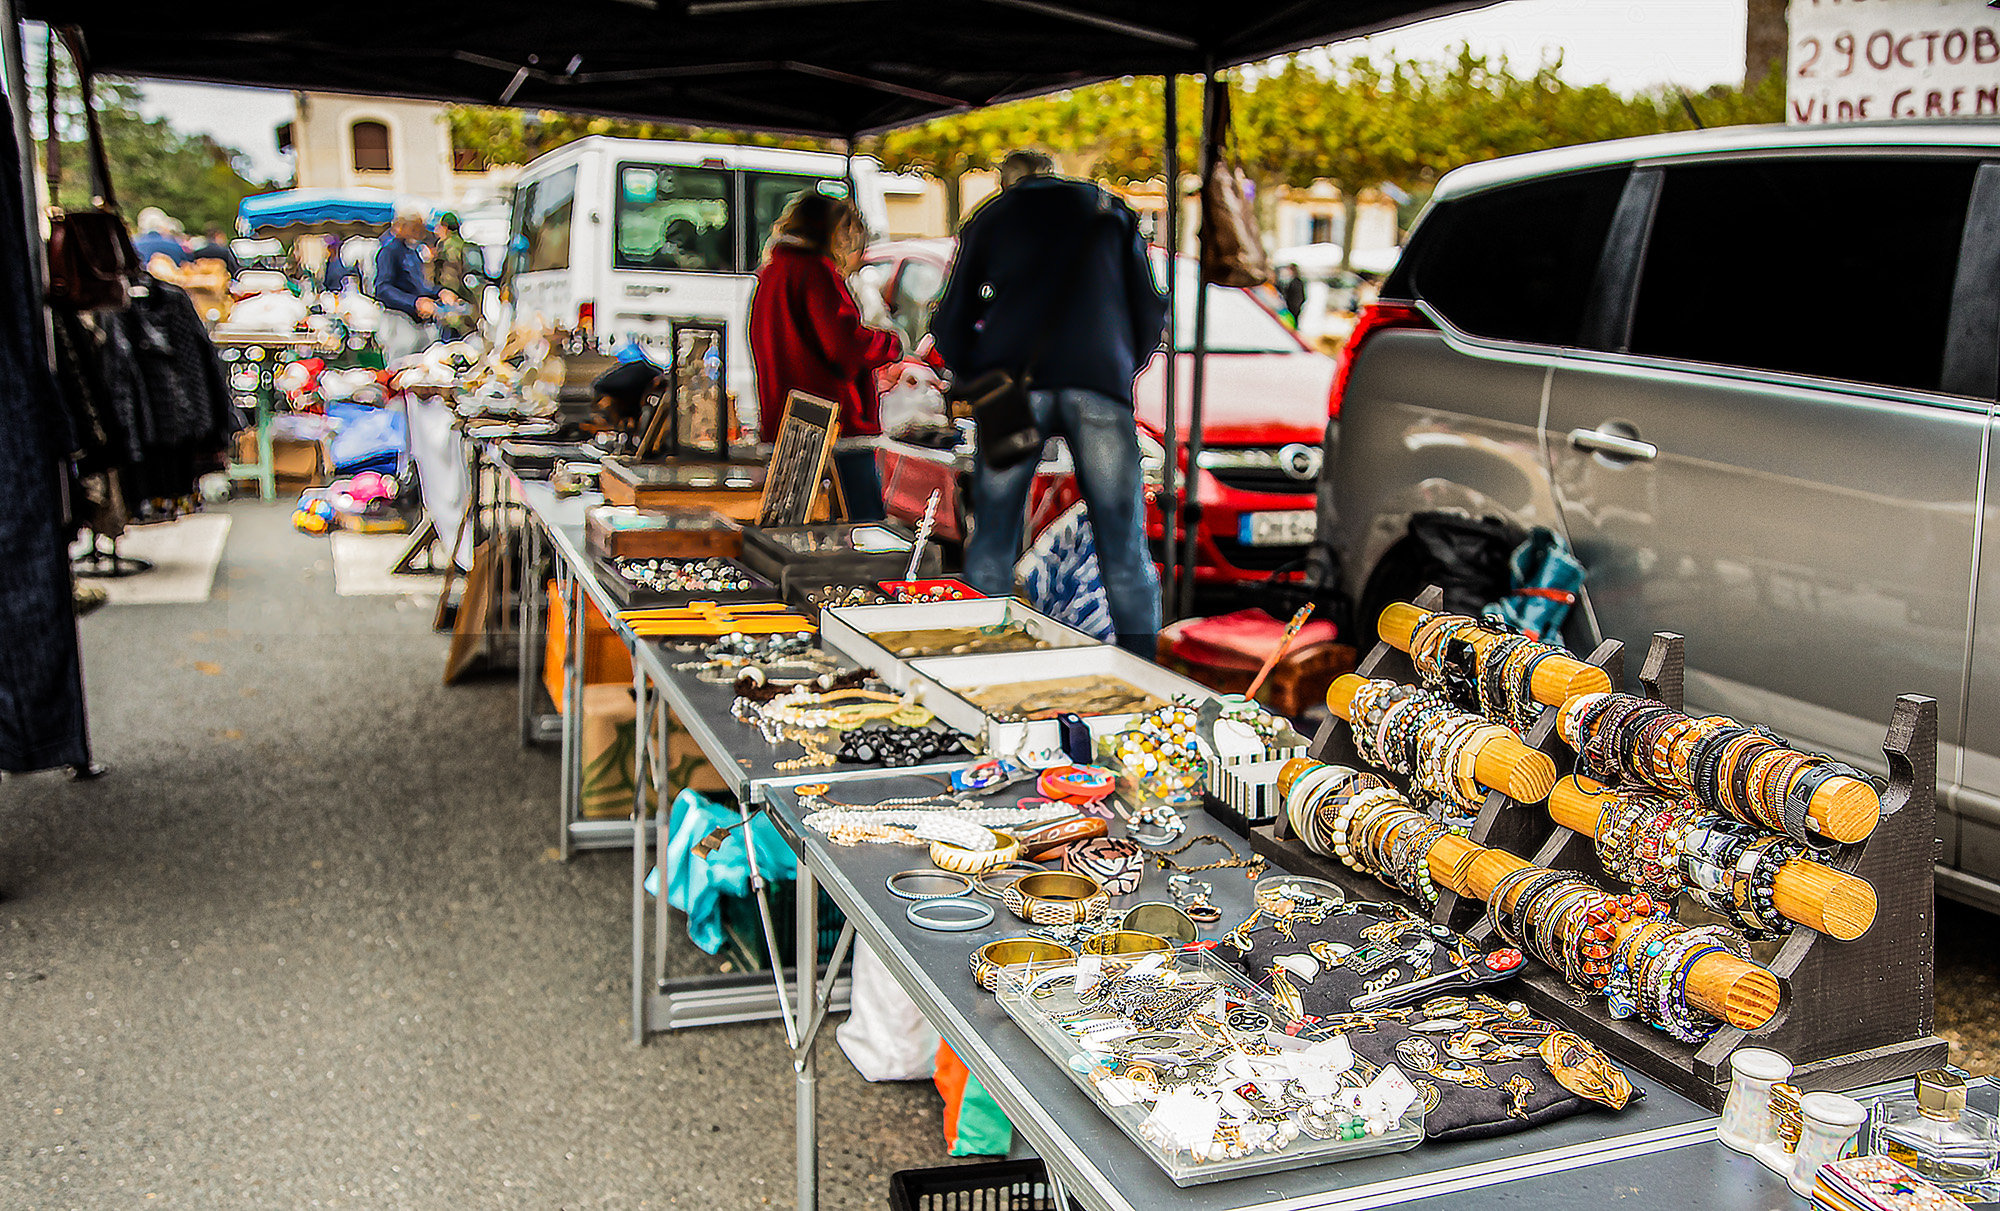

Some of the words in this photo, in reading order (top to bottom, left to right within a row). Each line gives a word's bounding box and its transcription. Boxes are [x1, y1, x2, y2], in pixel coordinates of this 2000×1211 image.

[1798, 31, 1856, 78] 29
[1866, 26, 2000, 71] OCTOB
[1363, 968, 1401, 995] 2000
